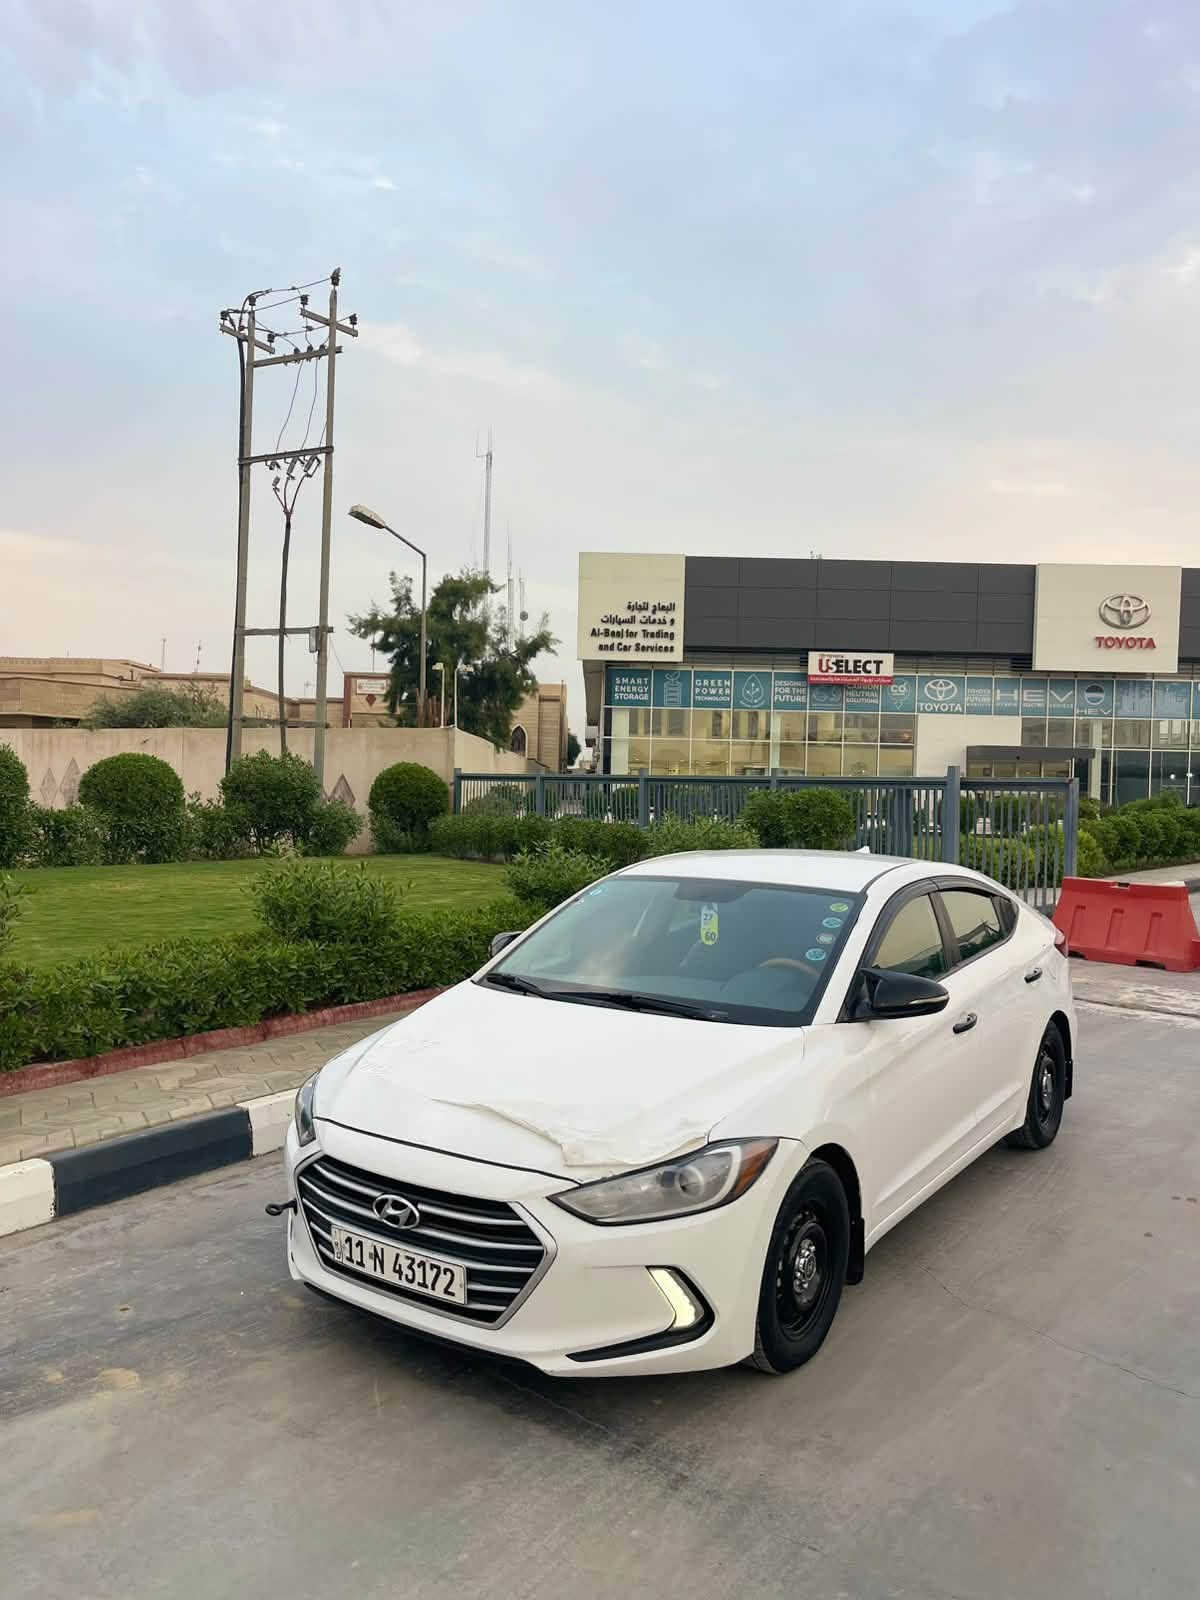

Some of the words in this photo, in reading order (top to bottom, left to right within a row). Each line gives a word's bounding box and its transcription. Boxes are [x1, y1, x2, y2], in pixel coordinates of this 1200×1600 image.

[601, 614, 636, 625] السيارات
[640, 615, 667, 624] خدمات
[669, 618, 675, 626] و
[625, 628, 638, 638] for
[641, 629, 675, 640] Trading
[1094, 636, 1156, 649] TOYOTA
[598, 643, 615, 651] and
[617, 643, 632, 651] Car
[634, 643, 674, 652] Services
[615, 677, 649, 685] SMART
[695, 679, 730, 687] GREEN
[615, 685, 649, 693] ENERGY
[695, 687, 730, 695] POWER
[791, 687, 806, 695] THE
[614, 693, 649, 701] STORAGE
[775, 695, 806, 703] FUTURE
[919, 702, 962, 712] TOYOTA
[344, 1236, 365, 1268] 11
[373, 1245, 384, 1274] N
[392, 1252, 456, 1297] 43172
